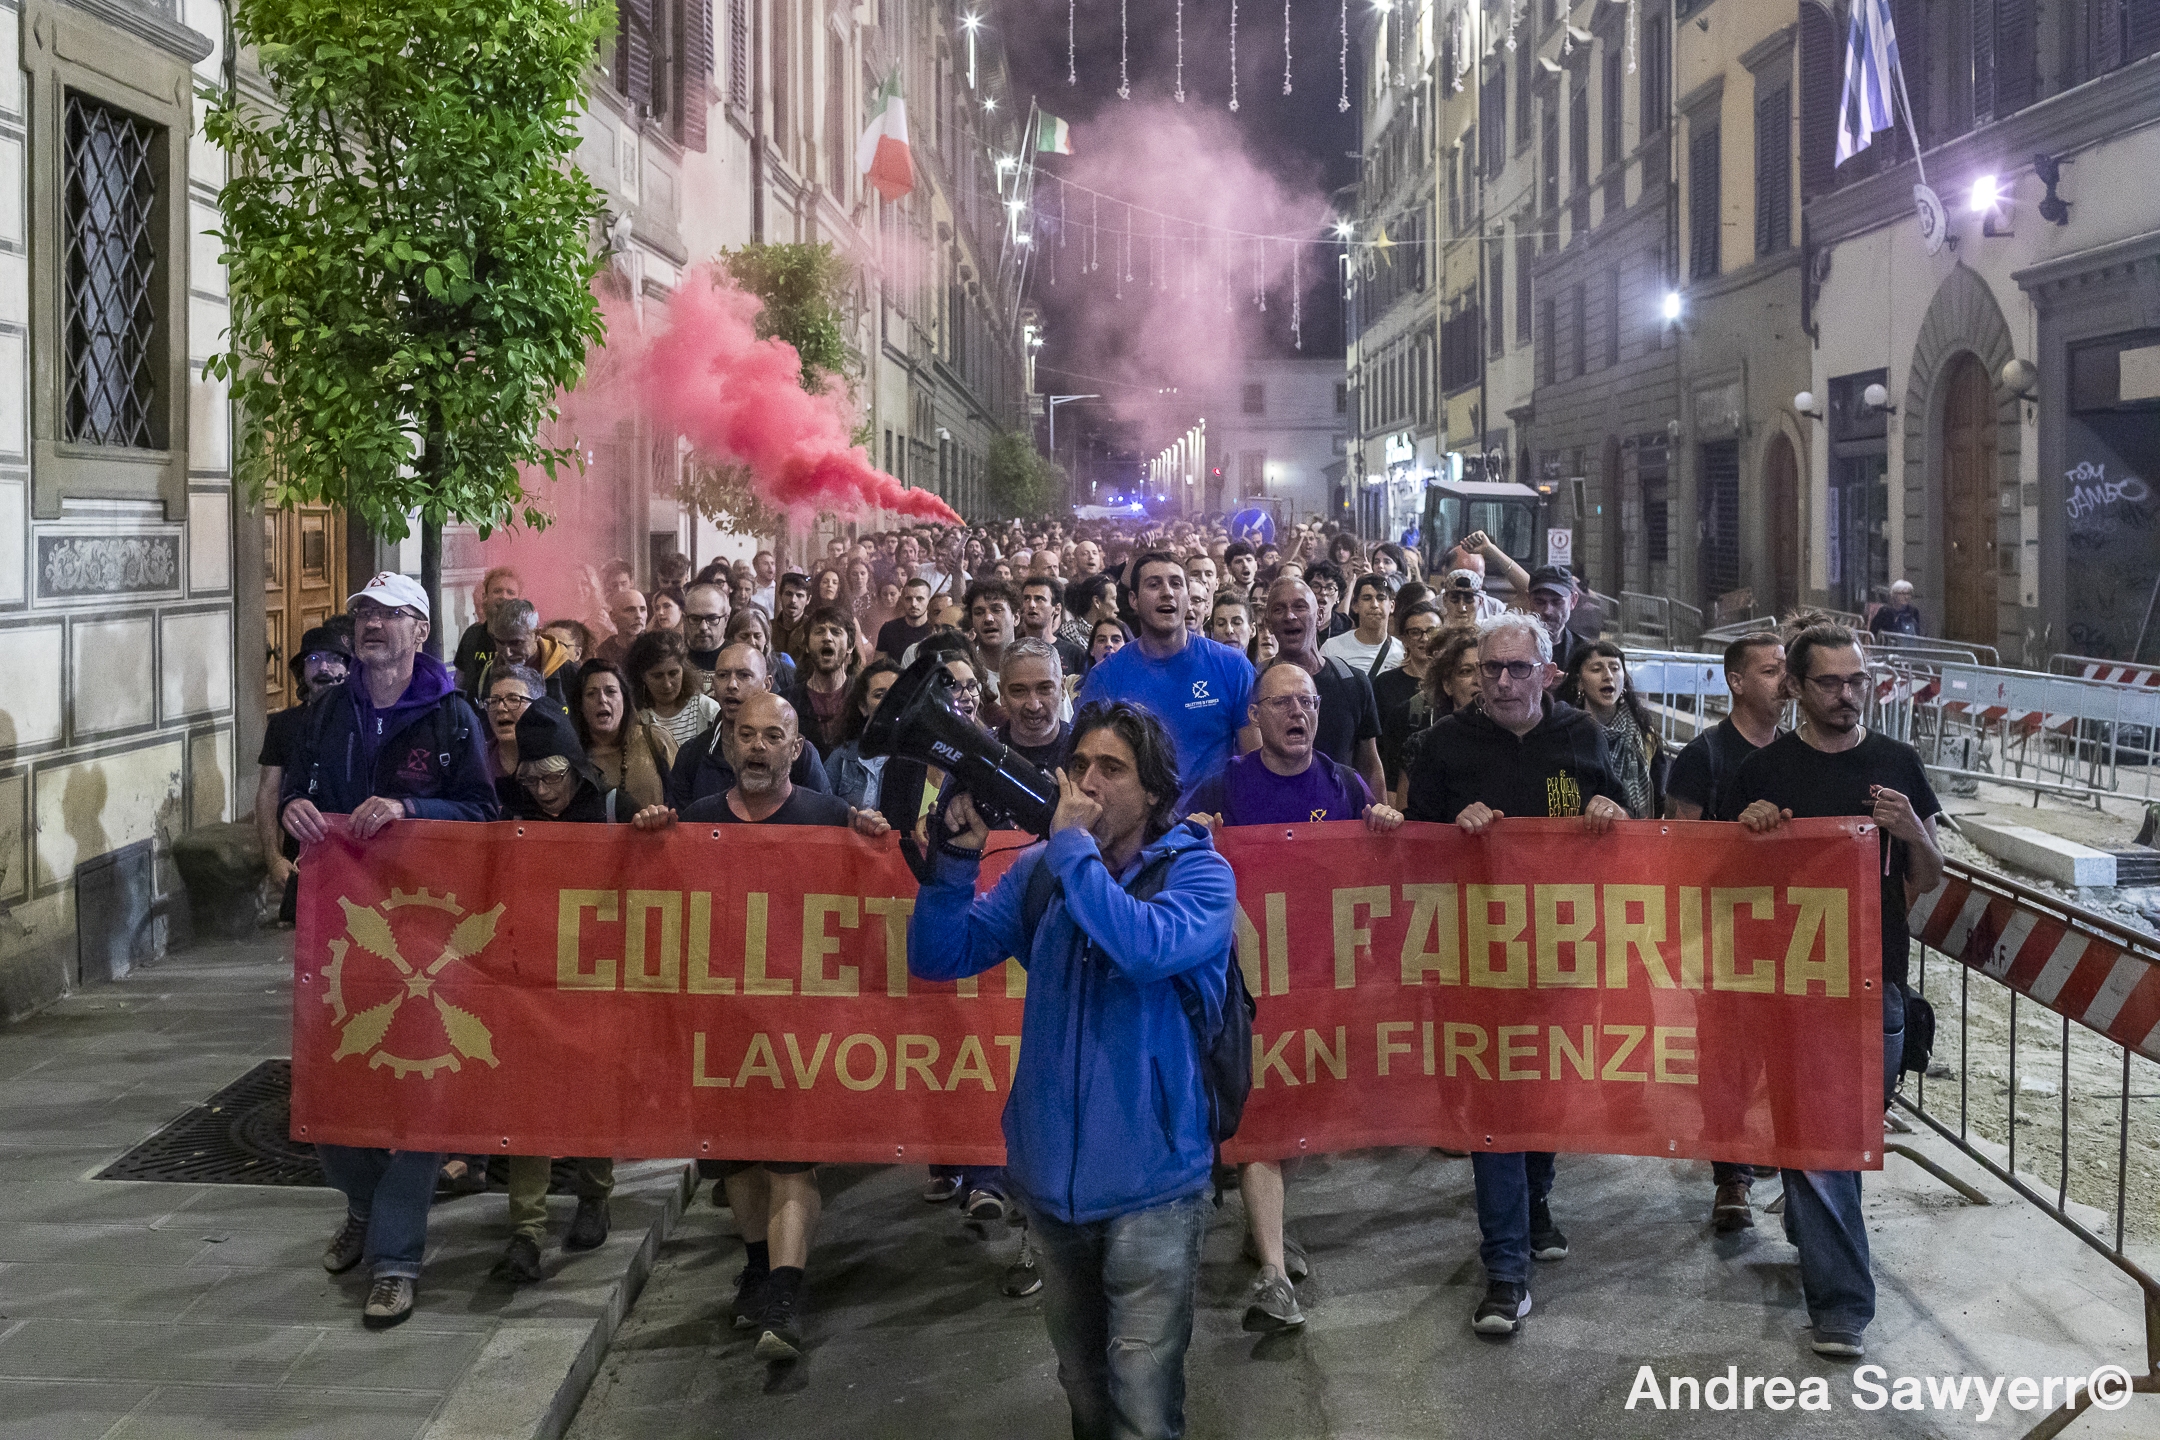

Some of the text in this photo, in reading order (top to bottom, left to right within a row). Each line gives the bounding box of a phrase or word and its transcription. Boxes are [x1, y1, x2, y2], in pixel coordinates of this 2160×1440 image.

[931, 740, 963, 763] PYLE
[557, 888, 1027, 998] COLLET
[1332, 883, 1850, 998] FABBRICA
[693, 1021, 1699, 1092] LAVORAT KN FIRENZE
